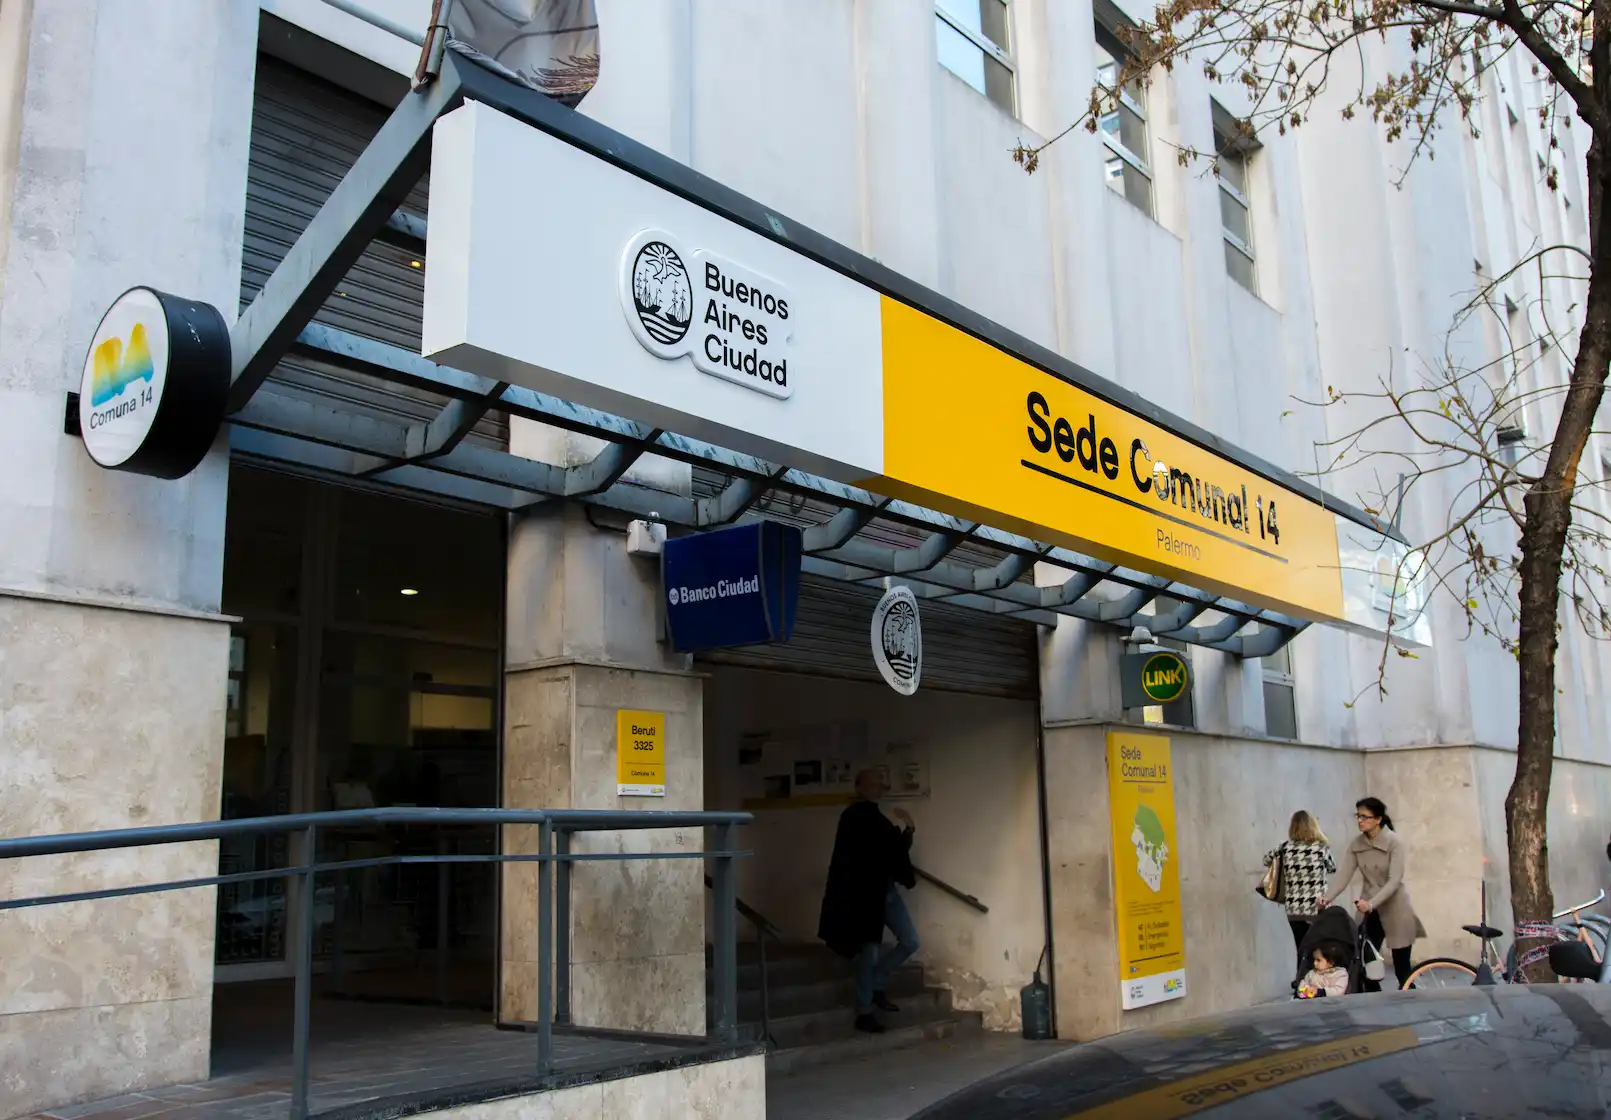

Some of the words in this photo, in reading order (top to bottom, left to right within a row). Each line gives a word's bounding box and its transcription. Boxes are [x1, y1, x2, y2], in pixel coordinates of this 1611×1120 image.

[705, 261, 789, 320] Buenos
[704, 299, 768, 346] Aires
[704, 334, 787, 387] Ciudad
[90, 398, 137, 430] Comuna
[140, 386, 153, 408] 14
[1027, 391, 1119, 480] Sede
[1130, 438, 1250, 534] Comunal
[1255, 494, 1280, 545] 14
[1157, 528, 1202, 560] Palermo
[680, 586, 717, 604] Banco
[717, 574, 760, 598] Ciudad
[1145, 664, 1183, 687] LINK
[631, 725, 656, 736] Beruti
[633, 741, 654, 751] 3325
[1121, 745, 1141, 760] Sede
[1121, 763, 1157, 778] Comunal
[1158, 764, 1167, 778] 14
